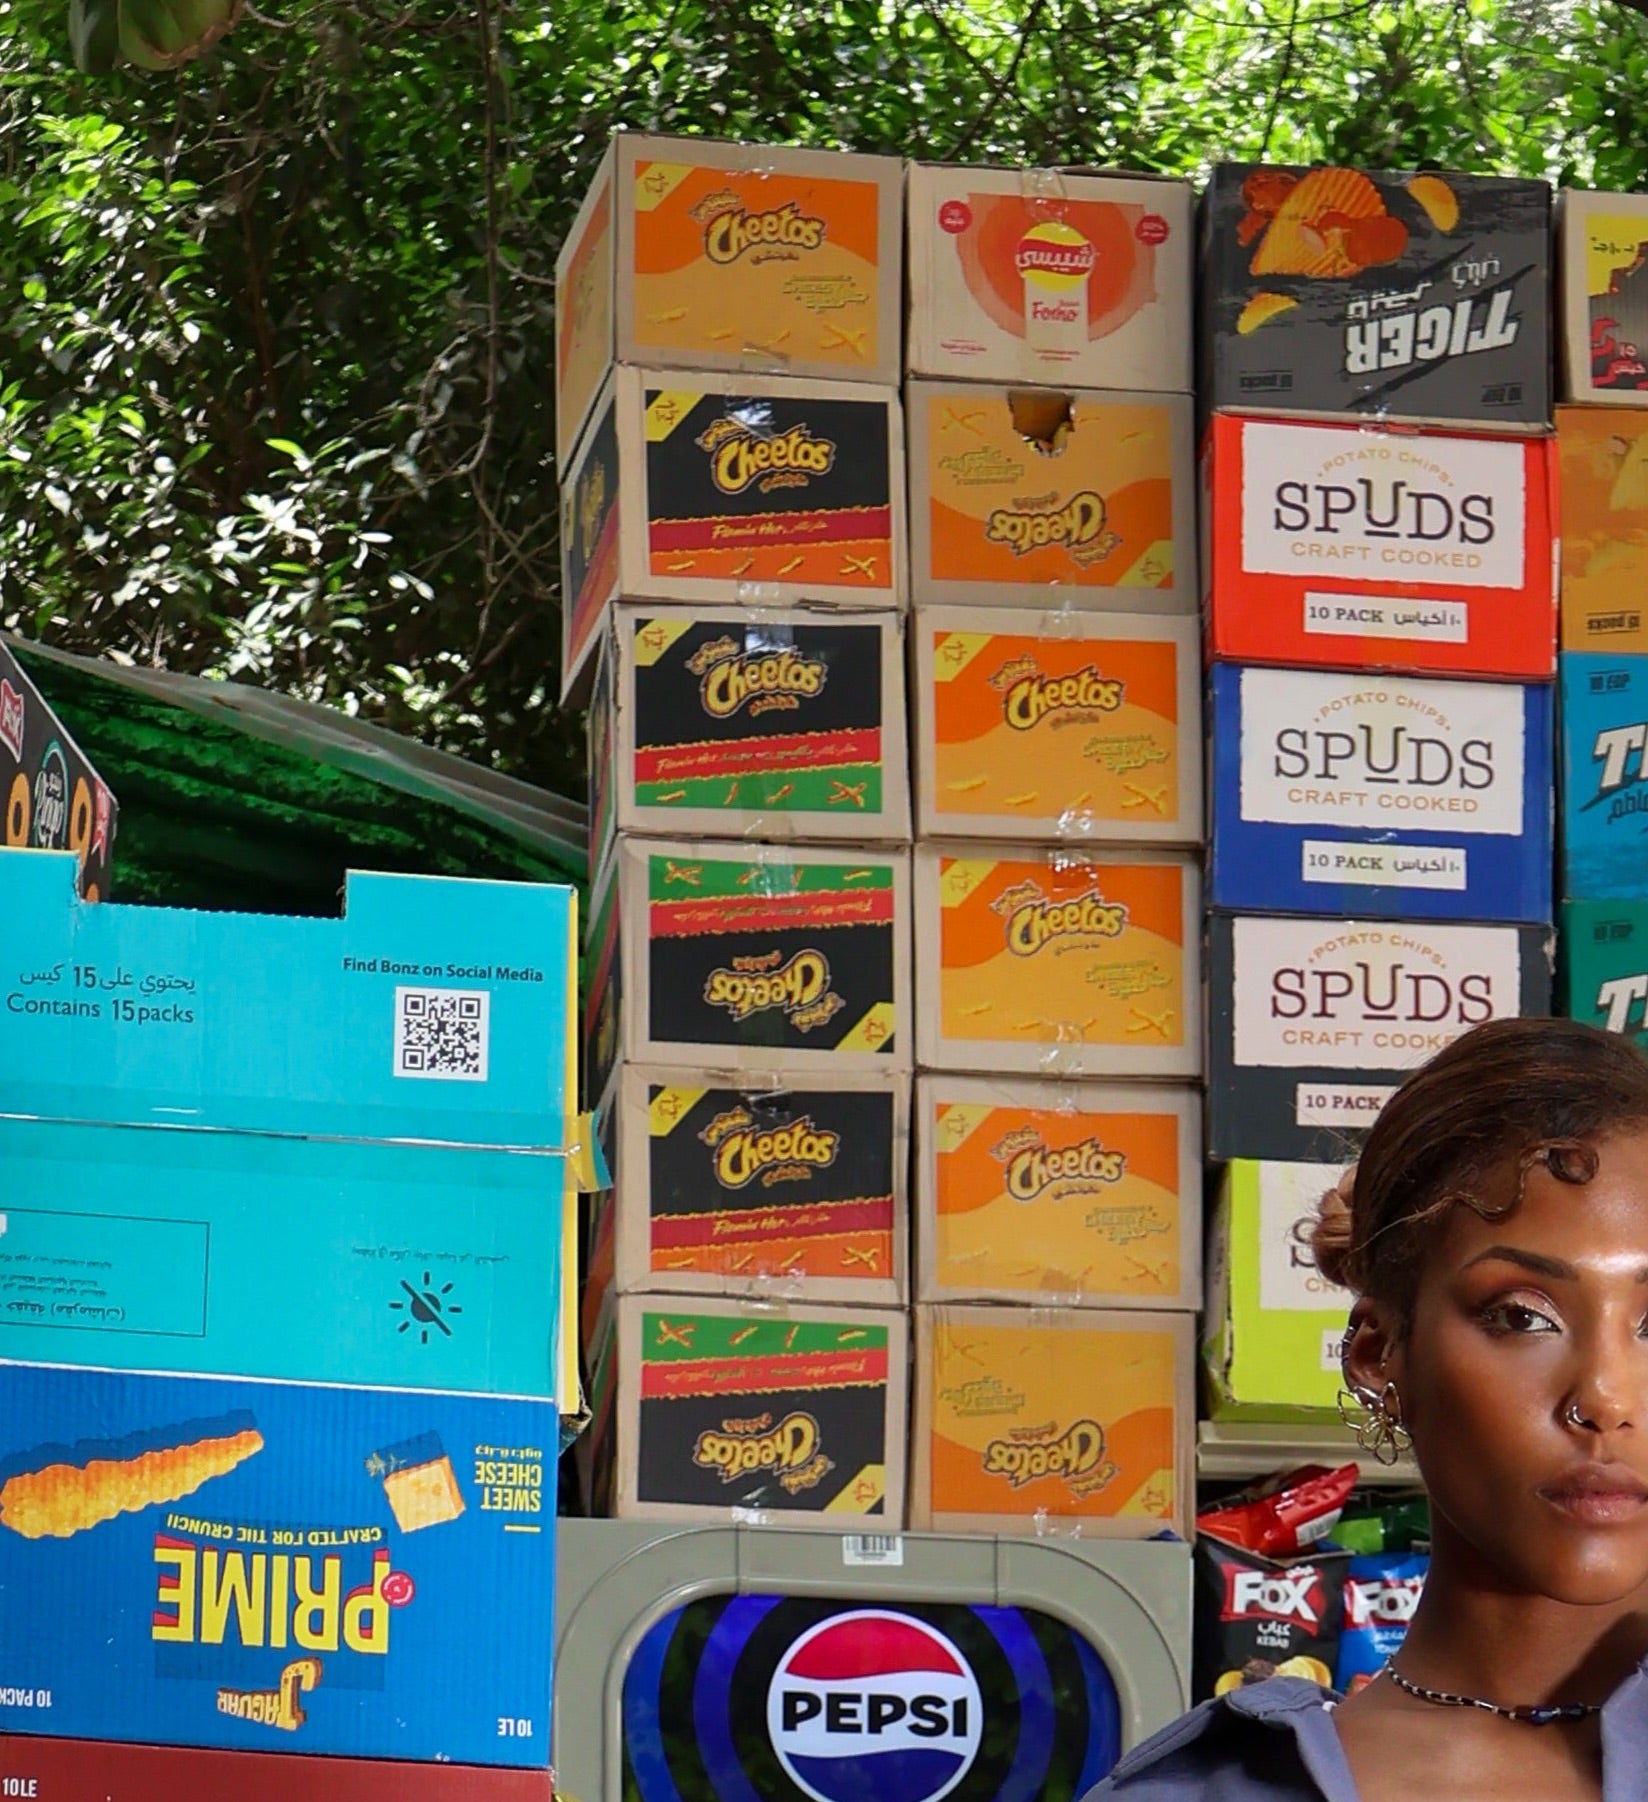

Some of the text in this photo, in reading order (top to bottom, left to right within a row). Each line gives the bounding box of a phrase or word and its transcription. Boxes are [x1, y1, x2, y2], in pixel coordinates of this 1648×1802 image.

[706, 205, 824, 264] Cheetos
[1345, 289, 1520, 374] TIGER
[714, 427, 833, 495] Cheetos
[1322, 447, 1452, 485] POTATO CHIPS
[987, 492, 1106, 555] Cheetos
[1274, 478, 1495, 544] SPUDS
[1291, 542, 1482, 569] CRAFT COOKED
[1309, 607, 1384, 624] 10 PACK
[703, 653, 826, 718] Cheetos
[1004, 673, 1124, 732] Cheetos
[1321, 691, 1447, 726] POTATO CHIPS
[1274, 724, 1494, 790] SPUDS
[1288, 789, 1478, 813] CRAFT COOKED
[1308, 854, 1383, 871] 10 PACK
[1008, 895, 1127, 956] Cheetos
[20, 964, 65, 986] كيس
[73, 966, 97, 988] 15
[343, 957, 543, 983] Find Bonz on Social Media
[706, 951, 828, 1015] Cheetos
[1271, 961, 1493, 1024] SPUDS
[7, 993, 194, 1025] Contains 15 packs
[1282, 1030, 1362, 1048] CRAFT
[1305, 1095, 1381, 1111] 10 PACK
[716, 1126, 837, 1188] Cheetos
[1008, 1143, 1126, 1200] Cheetos
[697, 1413, 818, 1480] Cheetos
[985, 1420, 1104, 1488] Cheetos
[474, 1461, 542, 1487] CHEESE
[481, 1486, 541, 1512] SWEET
[271, 1524, 304, 1541] FOR
[309, 1526, 382, 1543] CRAFTED
[152, 1545, 389, 1655] PRIME
[1232, 1570, 1320, 1622] FOX
[36, 1688, 52, 1708] 10
[217, 1657, 322, 1730] JAGUAR
[782, 1692, 968, 1738] PEPSI
[498, 1718, 533, 1736] 10 LE
